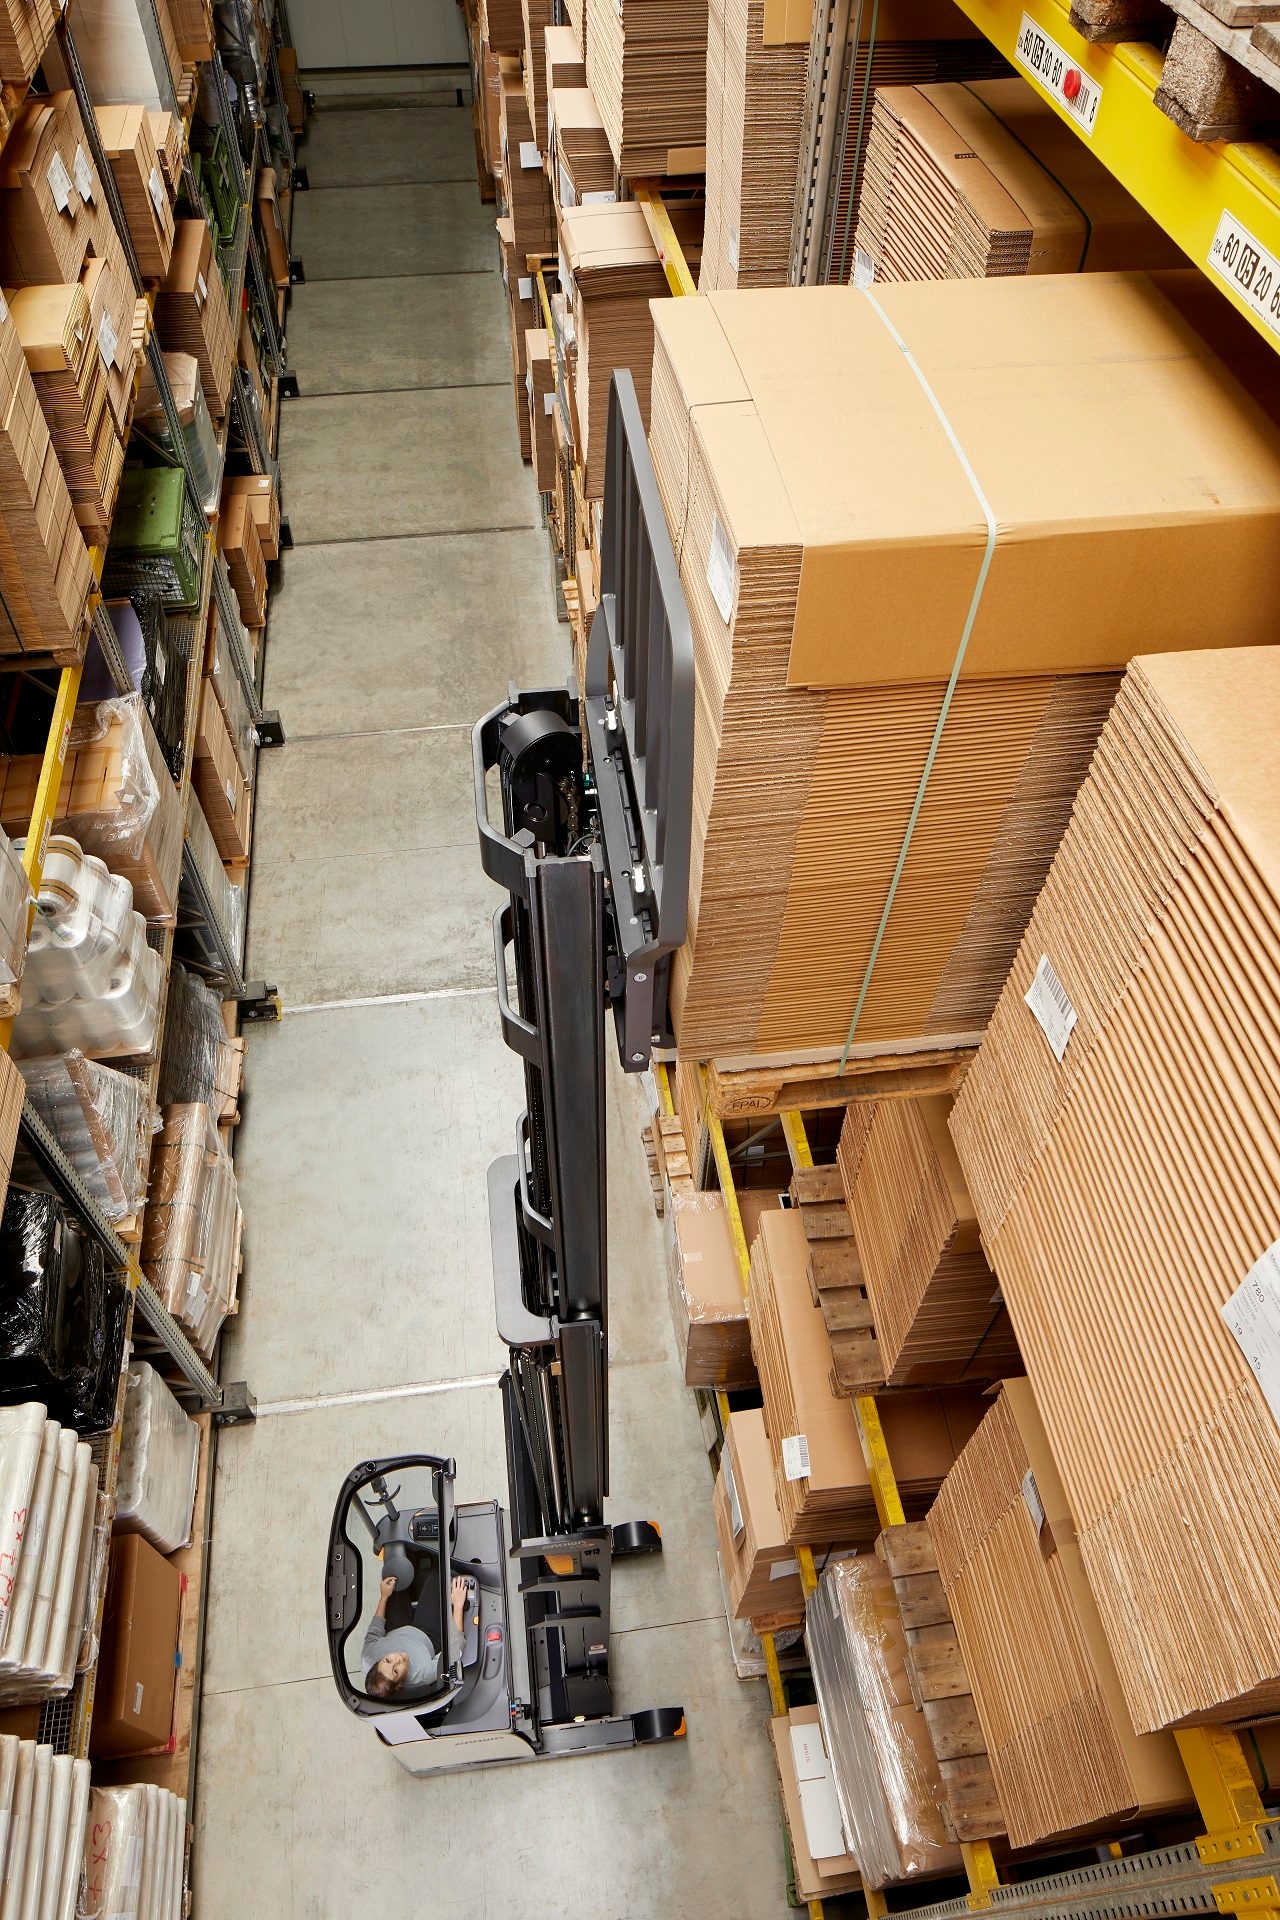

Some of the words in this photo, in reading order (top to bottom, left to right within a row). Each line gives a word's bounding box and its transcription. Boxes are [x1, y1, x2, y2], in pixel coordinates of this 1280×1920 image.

[1023, 28, 1034, 57] 60
[1042, 47, 1053, 78] 30
[1223, 233, 1240, 268] 60
[1236, 246, 1258, 288] 05
[1253, 265, 1272, 301] 20
[92, 1820, 112, 1846] 3
